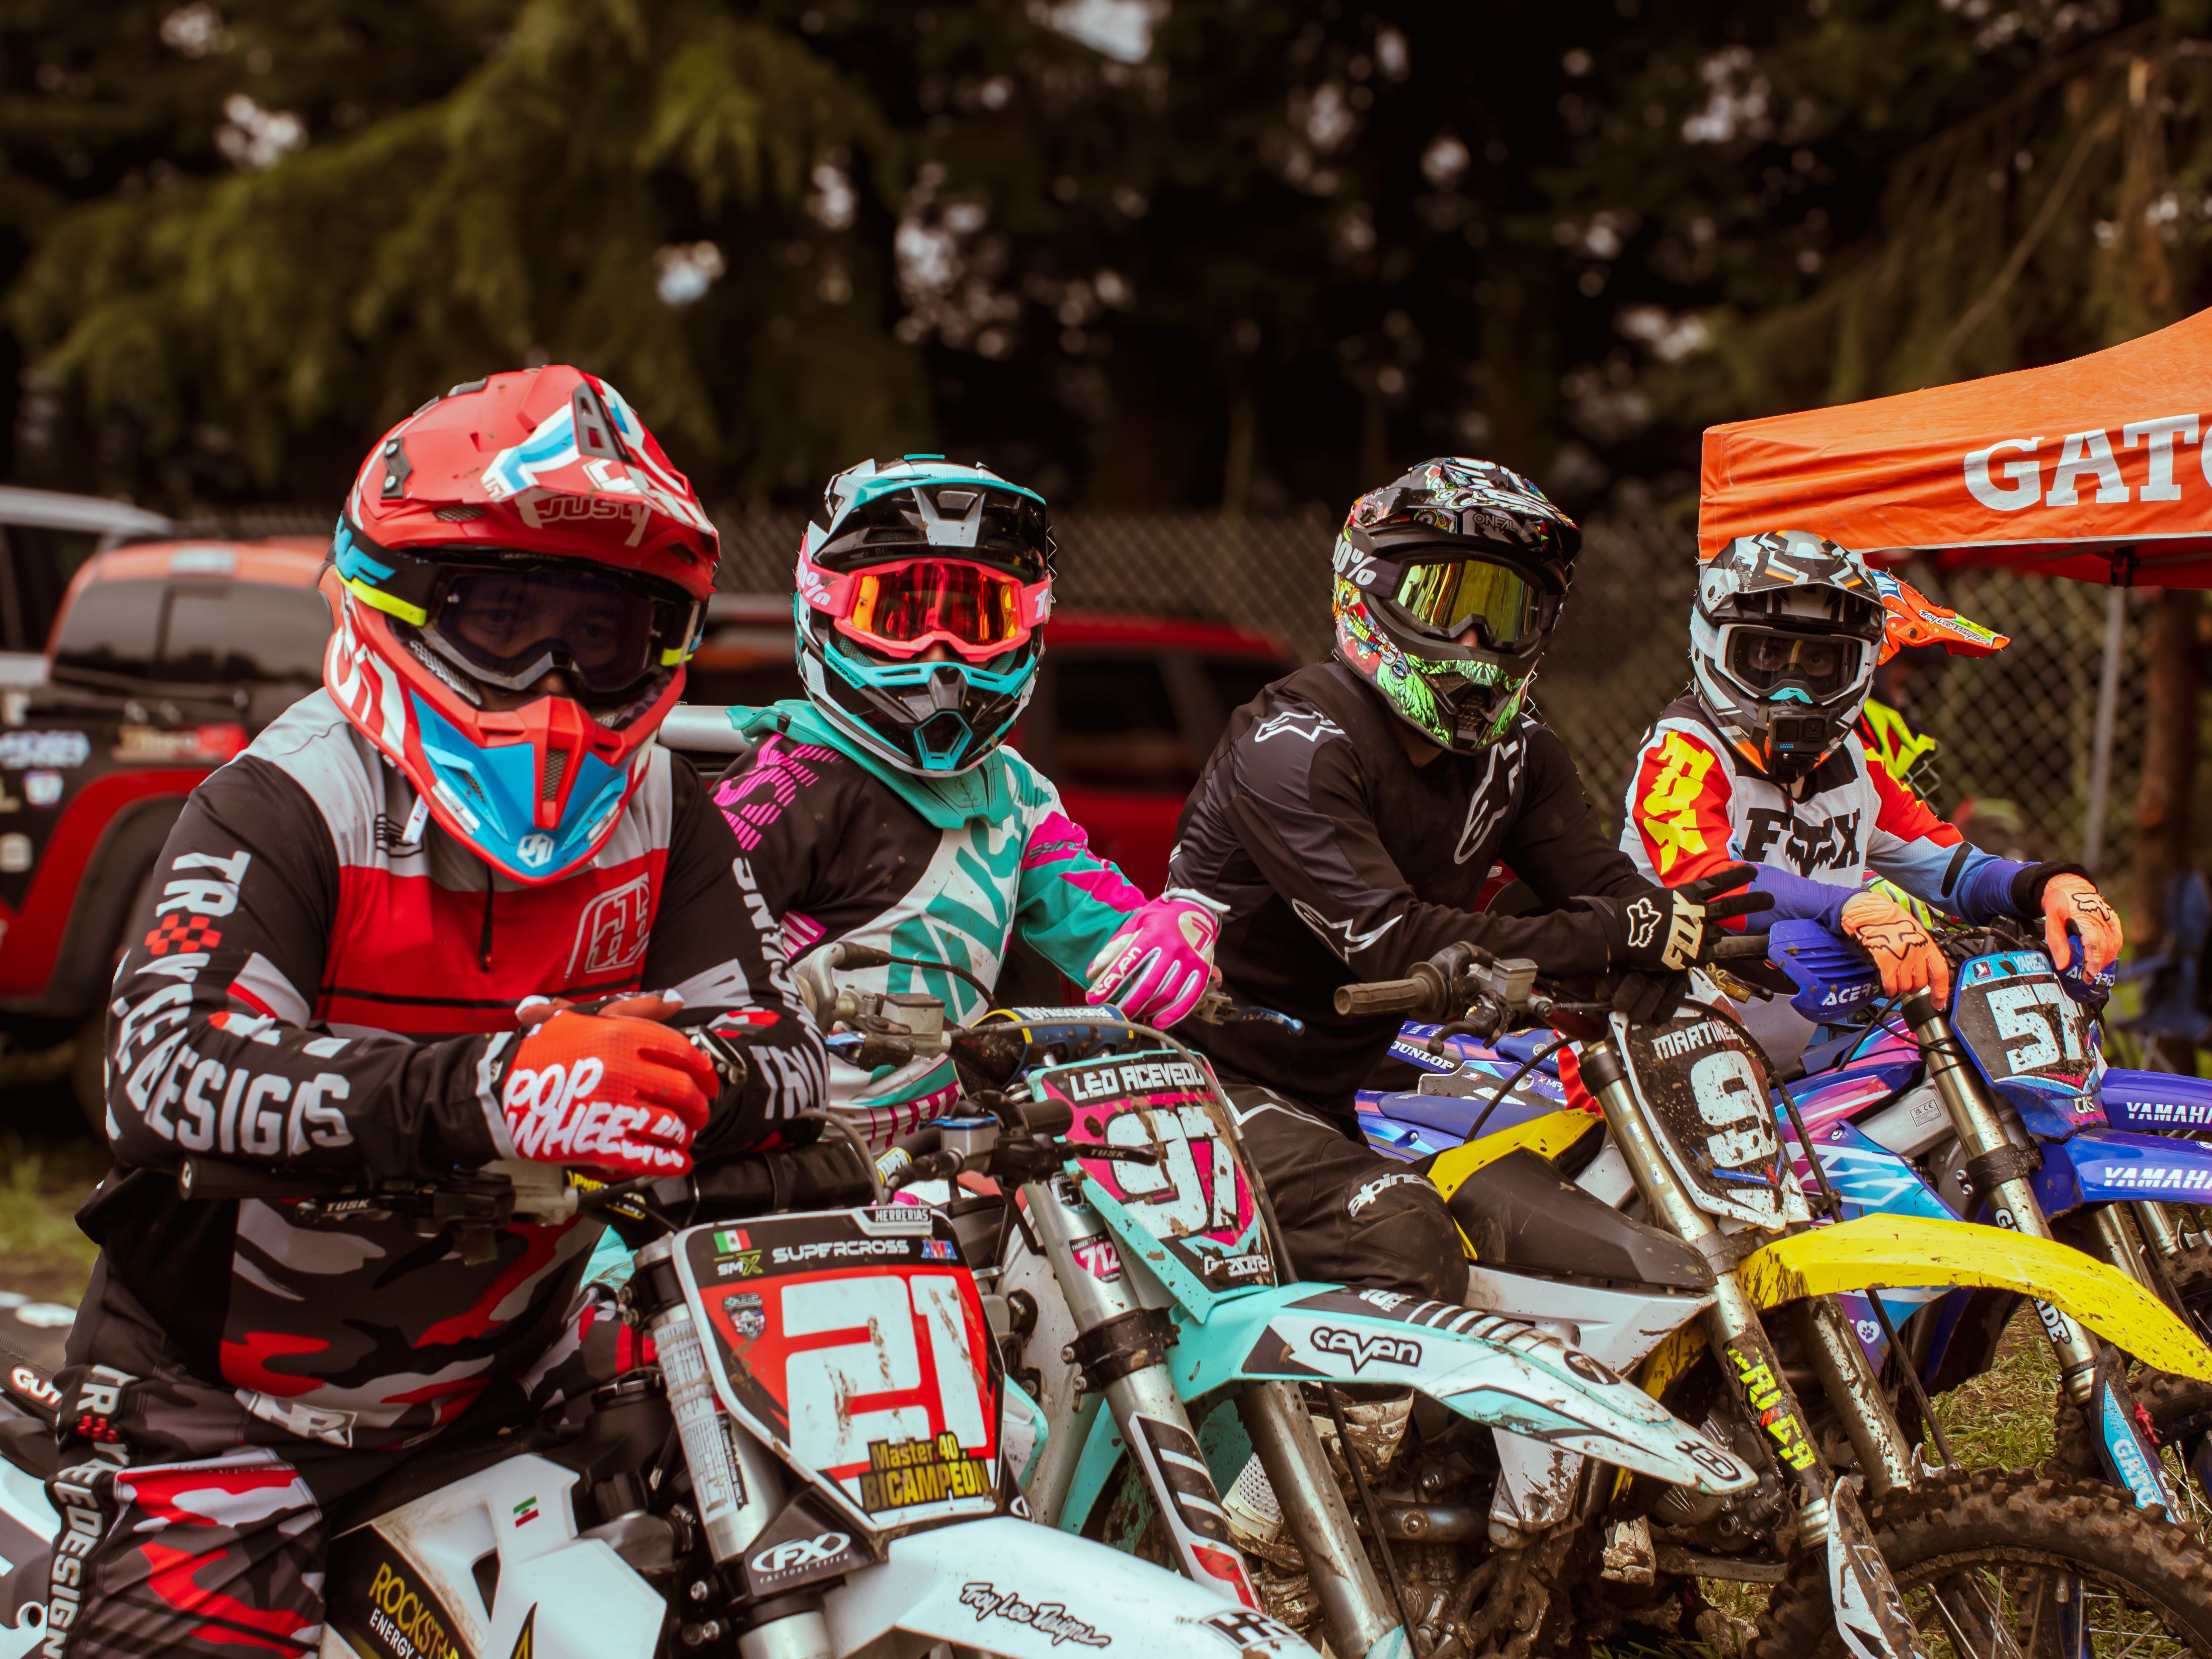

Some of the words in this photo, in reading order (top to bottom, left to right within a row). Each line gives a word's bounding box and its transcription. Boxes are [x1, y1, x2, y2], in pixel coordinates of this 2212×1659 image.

[1964, 414, 2212, 511] GAT
[1662, 890, 1705, 970] FOX
[1986, 983, 2083, 1074] 57
[505, 1057, 603, 1117] POP
[1069, 1065, 1121, 1102] LEO
[1107, 1106, 1238, 1238] 97
[874, 1209, 929, 1222] HERRERIAS
[772, 1239, 909, 1263] SUPERCROSS
[1079, 1241, 1121, 1278] 712
[781, 1275, 987, 1470] 21
[871, 1443, 935, 1470] Master
[938, 1434, 959, 1459] 40
[960, 1582, 994, 1622] Troy
[995, 1593, 1032, 1621] Lee
